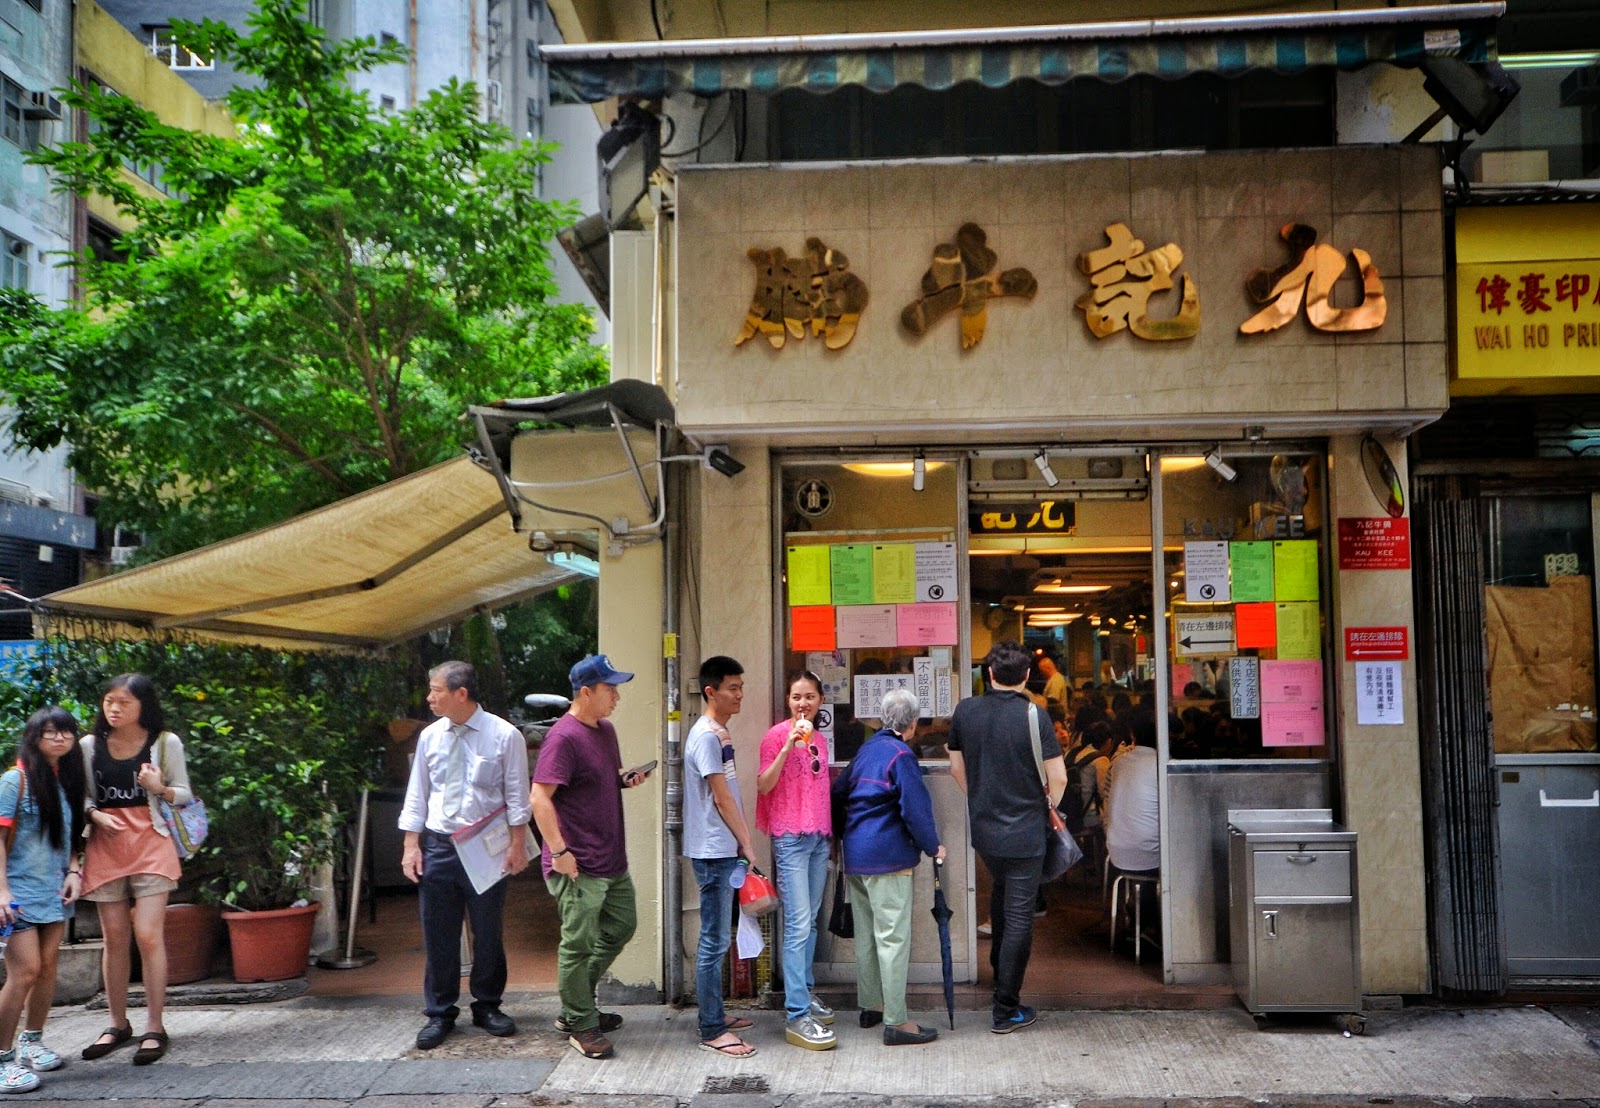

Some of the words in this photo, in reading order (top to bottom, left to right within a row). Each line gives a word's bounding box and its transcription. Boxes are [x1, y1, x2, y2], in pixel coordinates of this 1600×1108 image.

[1476, 272, 1600, 315] 偉豪印
[1475, 325, 1511, 349] WAI
[1523, 324, 1550, 348] HO
[1564, 323, 1600, 347] PRI
[1183, 517, 1235, 539] KAU
[1255, 514, 1305, 539] KEE
[917, 661, 931, 709] 不設留座
[1231, 658, 1243, 717] 只供客人使用
[1245, 657, 1257, 717] 本店之洗手間
